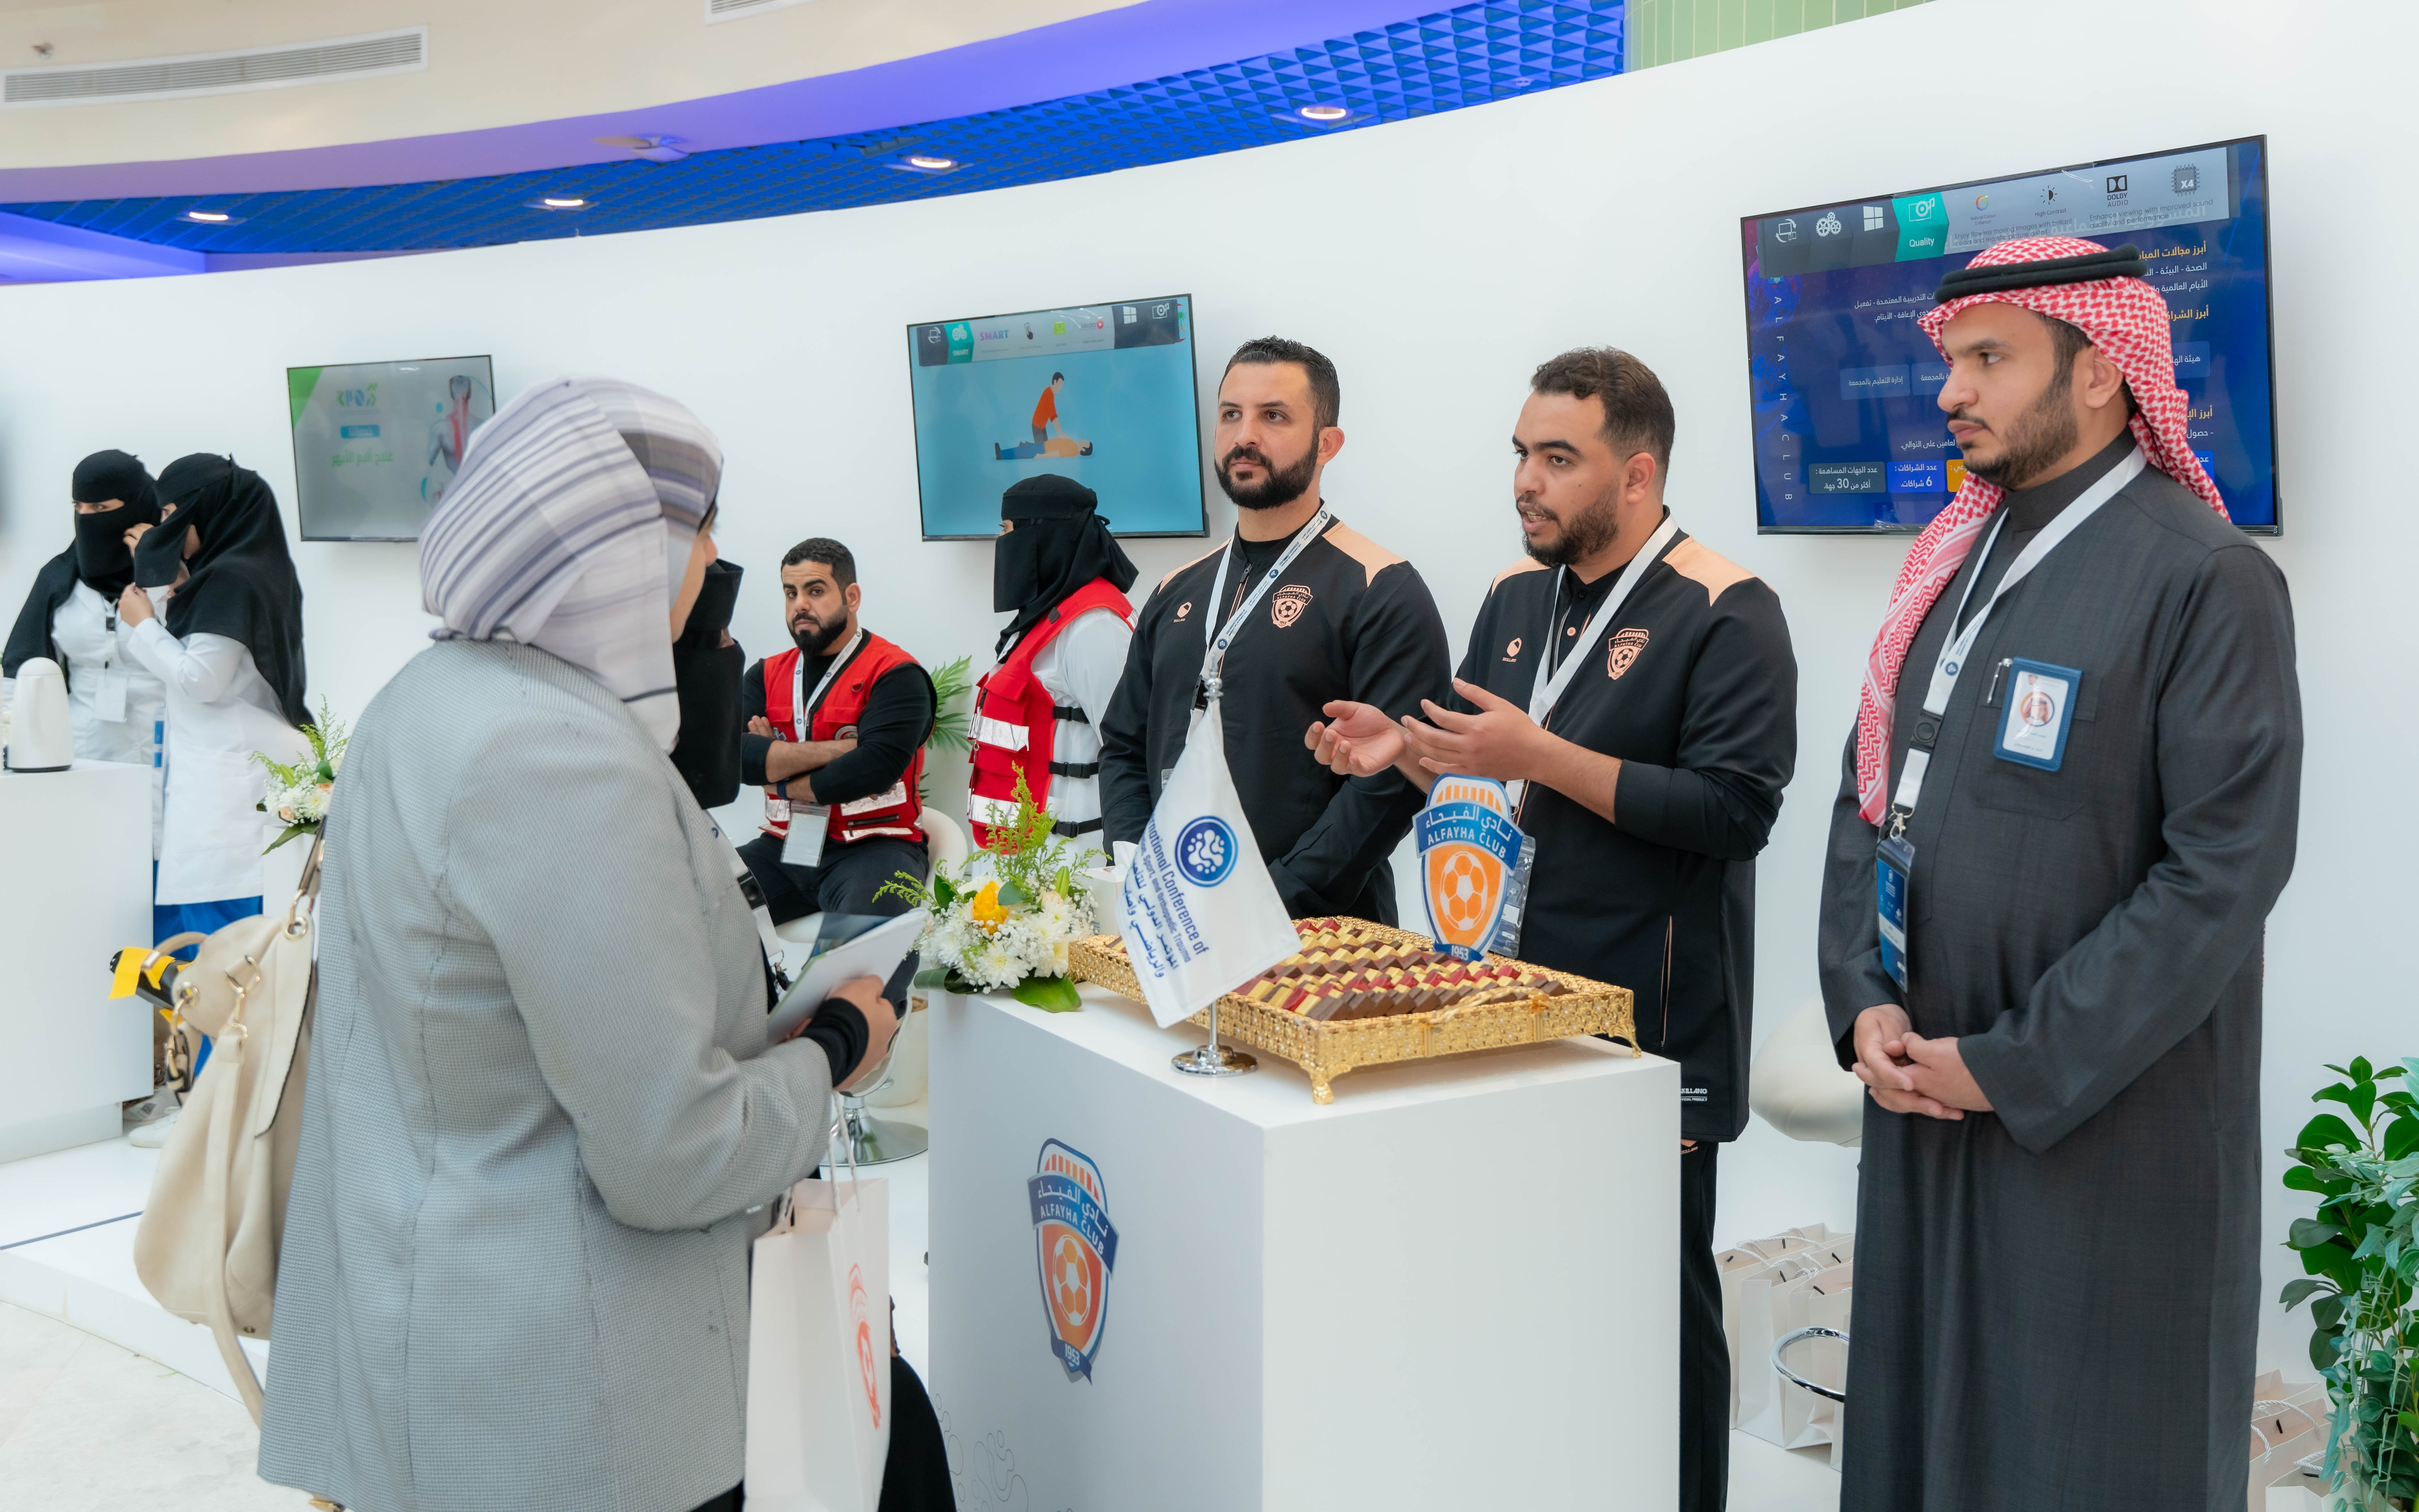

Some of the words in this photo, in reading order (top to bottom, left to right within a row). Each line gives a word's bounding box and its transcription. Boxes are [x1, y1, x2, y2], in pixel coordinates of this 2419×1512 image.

[2180, 179, 2194, 189] X4
[2107, 192, 2127, 201] DOLBY
[2089, 213, 2117, 221] Enhance
[2160, 202, 2191, 212] improved
[2193, 199, 2213, 207] sound
[2090, 221, 2111, 229] quality
[2127, 214, 2169, 224] performance
[1971, 230, 1992, 238] flawless
[1986, 234, 2007, 242] realistic
[2009, 231, 2029, 240] picture
[1909, 238, 1935, 247] Quality
[2192, 240, 2206, 256] أبرز
[2162, 246, 2190, 257] مجالات
[2160, 265, 2179, 275] البيئة
[2185, 262, 2207, 272] الصحة
[2161, 282, 2187, 293] العالمية
[2189, 279, 2207, 292] الأيام
[1876, 296, 1902, 305] المعتمدة
[1903, 293, 1925, 303] التدريبية
[1854, 300, 1871, 309] تفعيل
[1897, 310, 1915, 319] الإعاقة
[2195, 304, 2208, 319] أبرز
[980, 330, 1009, 341] SMART
[2184, 355, 2200, 363] هيئة
[1849, 378, 1871, 387] بالمجمعة
[1872, 377, 1890, 387] التعليم
[1891, 376, 1903, 384] إدارة
[1920, 373, 1944, 382] بالمجمعة
[2199, 405, 2212, 419] أبرز
[2186, 429, 2208, 438] حصول
[1923, 440, 1935, 449] على
[1936, 439, 1955, 448] لعامين
[1848, 466, 1866, 475] الجهات
[1898, 464, 1924, 472] الشراكات
[1823, 483, 1835, 491] جهة.
[1837, 478, 1849, 489] 30
[1860, 479, 1871, 489] أكثر
[1901, 479, 1924, 488] شراكات.
[1926, 476, 1933, 487] 6
[1426, 805, 1480, 828] الفيحاء
[1481, 816, 1513, 842] نادي
[1428, 827, 1475, 846] ALFAYHA
[1479, 832, 1507, 858] CLUB
[1137, 893, 1163, 930] الدولي
[1143, 854, 1155, 878] Sport,
[1152, 878, 1162, 893] and
[1173, 932, 1192, 963] Trauma
[1162, 871, 1199, 941] Conference
[1193, 941, 1209, 955] of
[1129, 919, 1165, 978] والرياضي
[1156, 933, 1179, 970] المؤتمر
[1451, 945, 1469, 961] 1953
[1038, 1180, 1080, 1205] الفيحاء
[1082, 1203, 1108, 1237] نادي
[1040, 1203, 1078, 1226] ALFAYHA
[1081, 1219, 1104, 1255] CLUB
[1065, 1343, 1080, 1365] 1953
